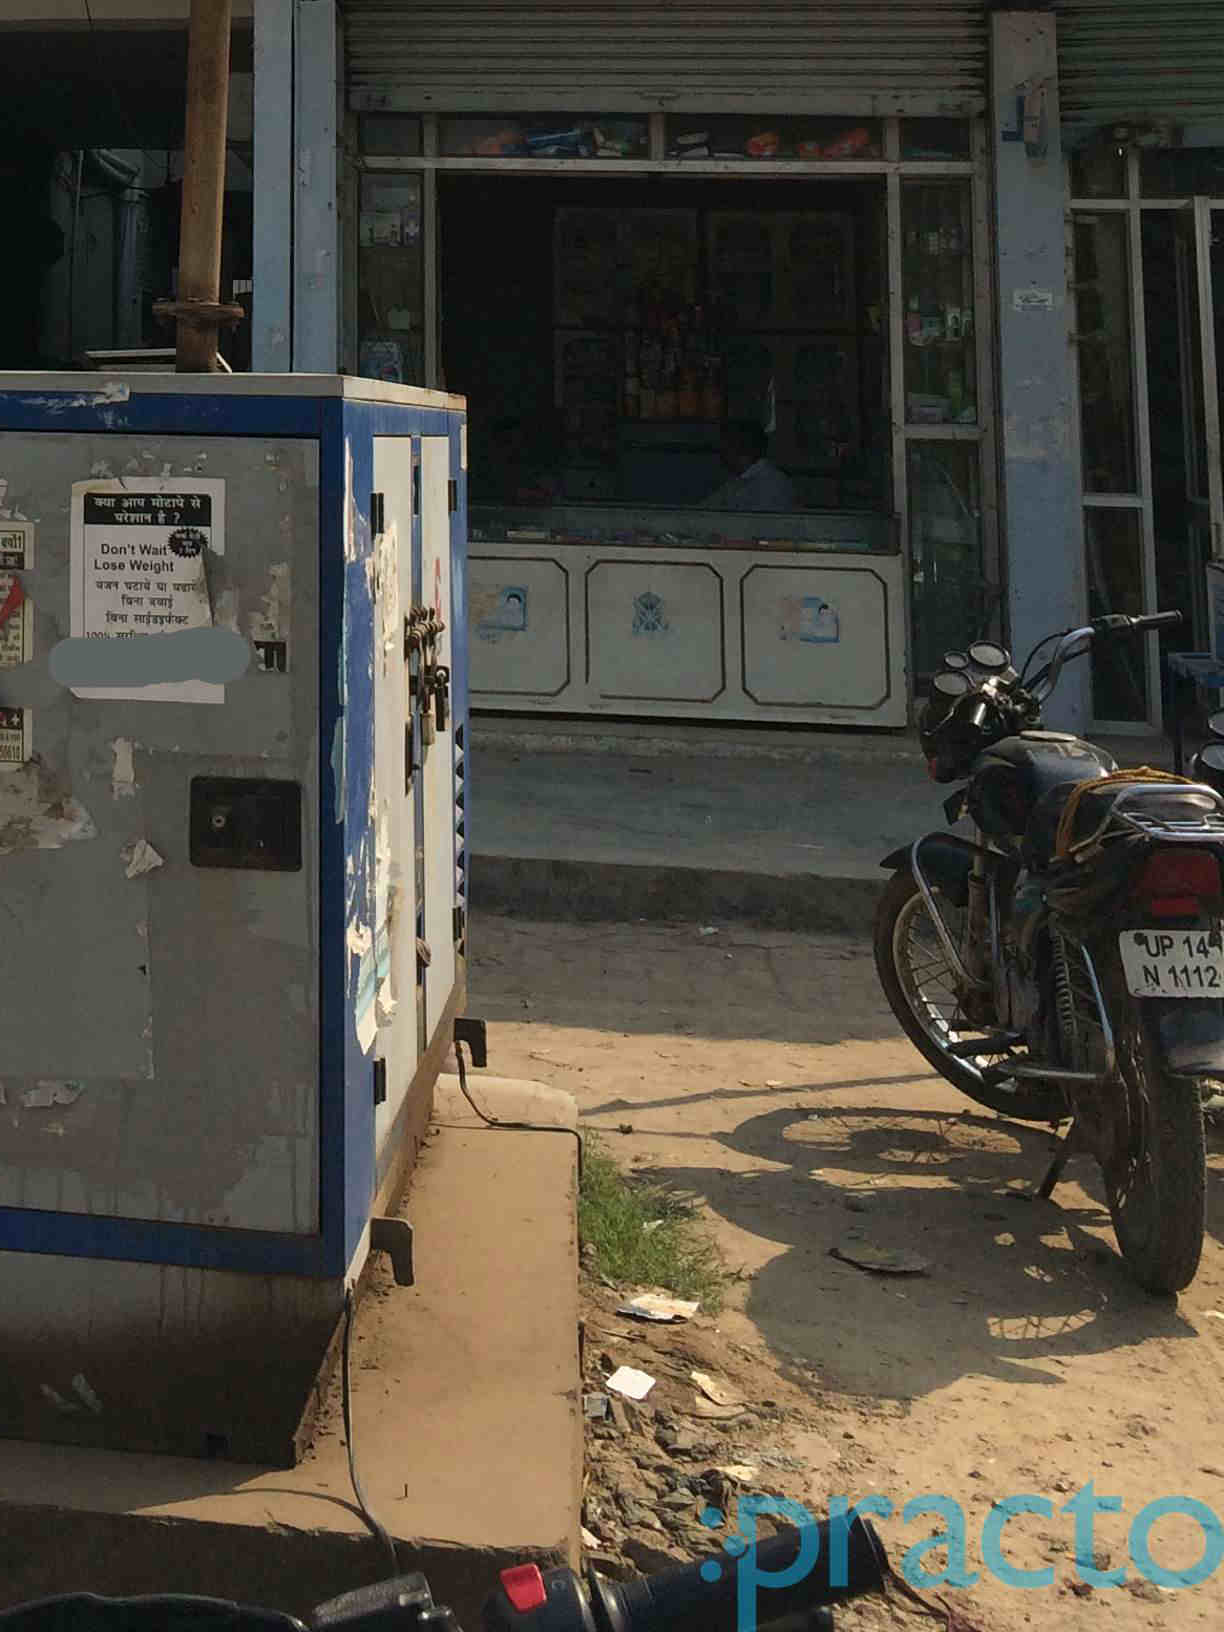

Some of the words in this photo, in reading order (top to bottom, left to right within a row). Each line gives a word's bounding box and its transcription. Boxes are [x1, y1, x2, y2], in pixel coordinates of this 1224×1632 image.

[122, 496, 145, 508] आप
[101, 543, 135, 555] Don't
[139, 543, 167, 555] Wait
[94, 559, 126, 571] Lose
[130, 559, 174, 574] Weight
[1144, 935, 1174, 958] UP
[1142, 964, 1160, 987] N
[1168, 964, 1221, 988] 1112
